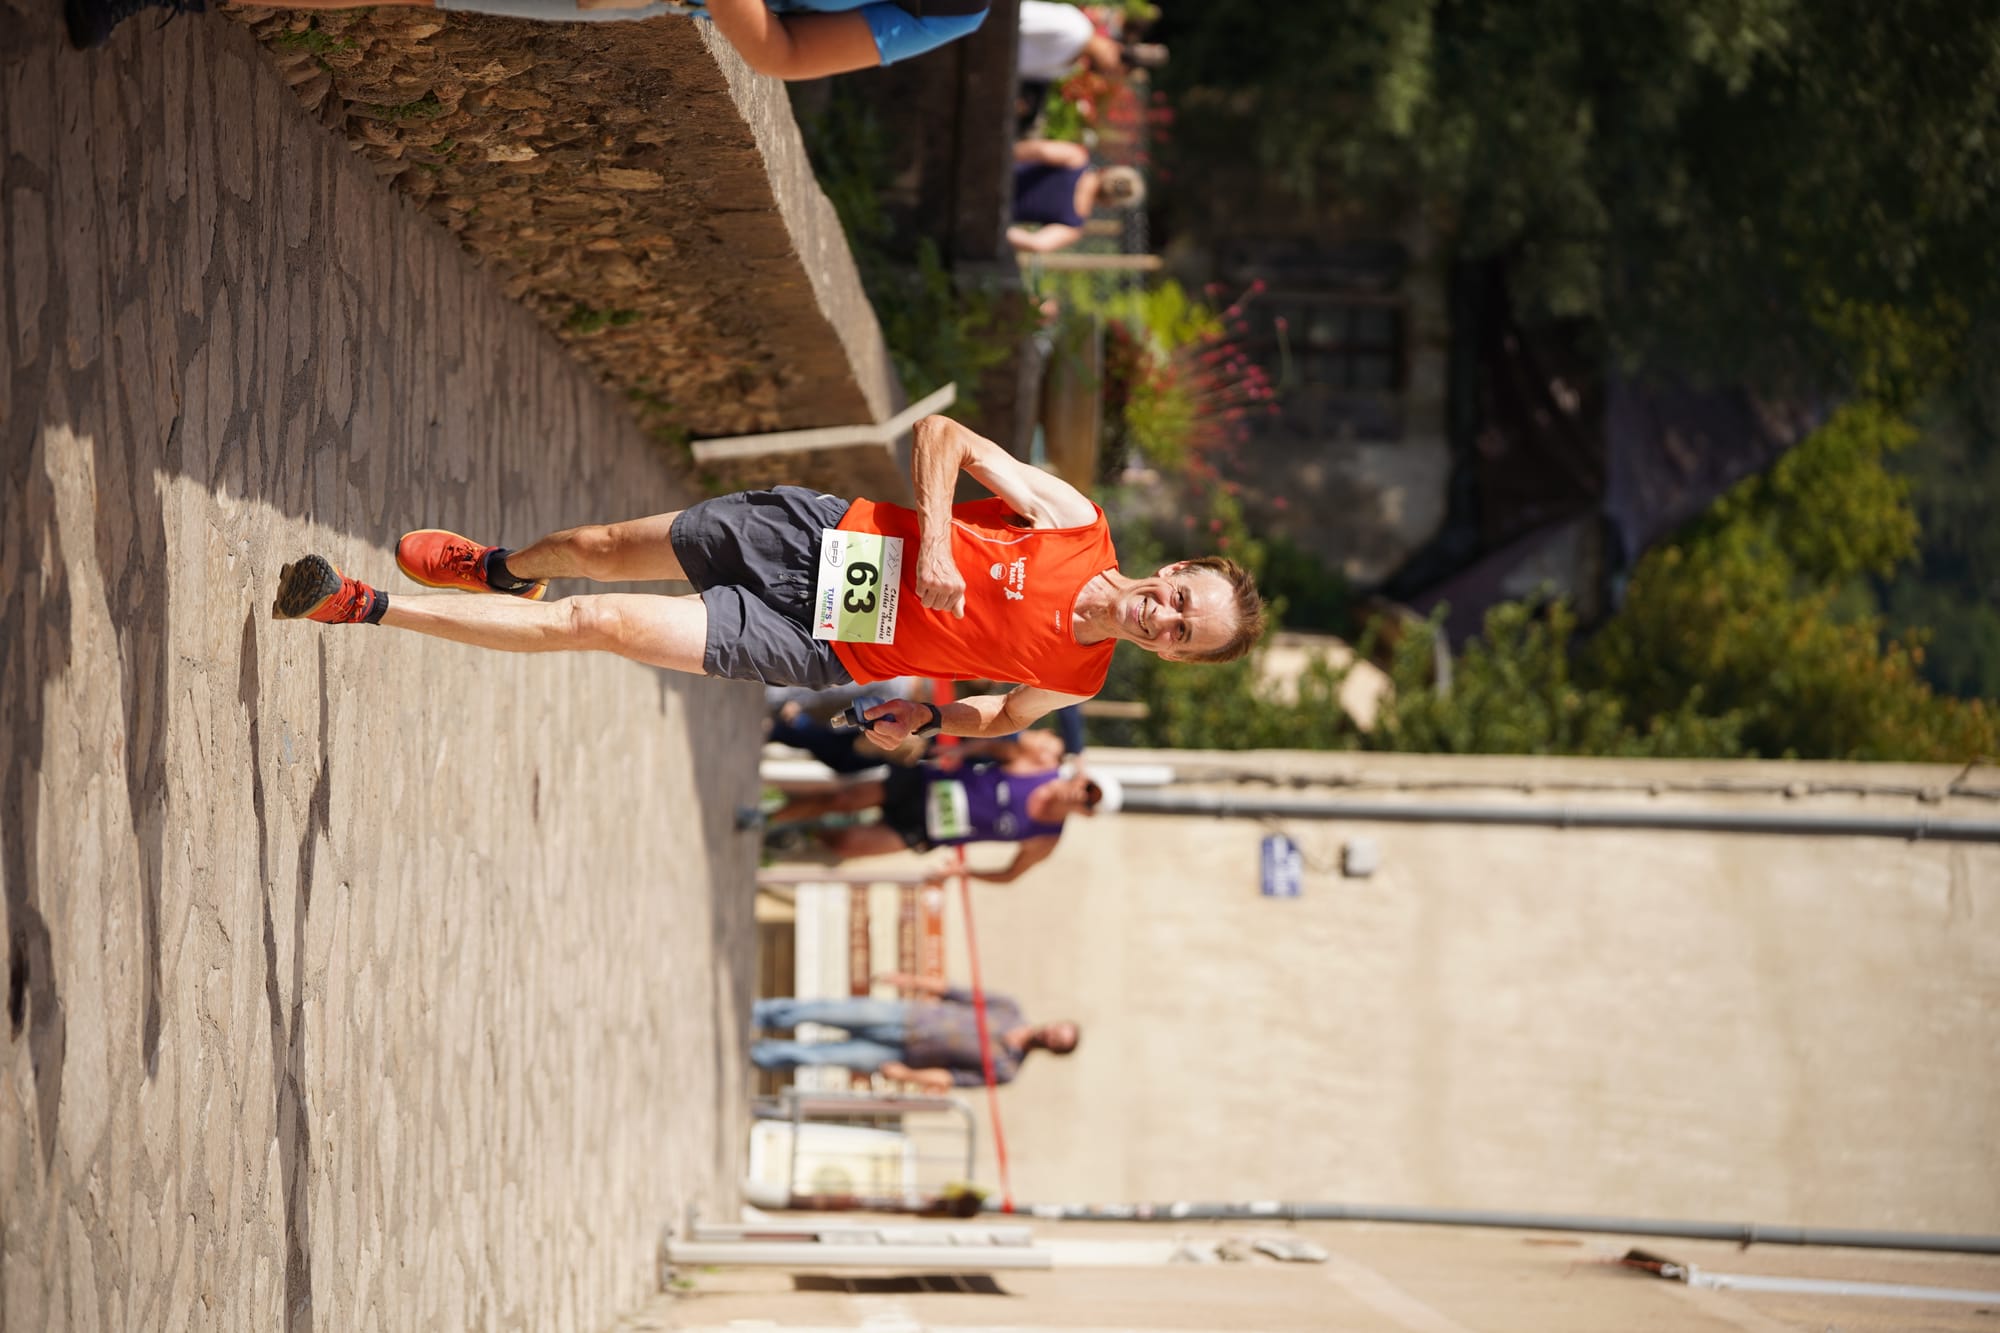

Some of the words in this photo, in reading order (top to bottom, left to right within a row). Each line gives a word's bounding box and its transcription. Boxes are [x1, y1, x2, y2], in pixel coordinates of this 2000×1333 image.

[825, 588, 834, 620] TUFF'S
[844, 562, 878, 614] 63
[886, 588, 896, 622] Challenge
